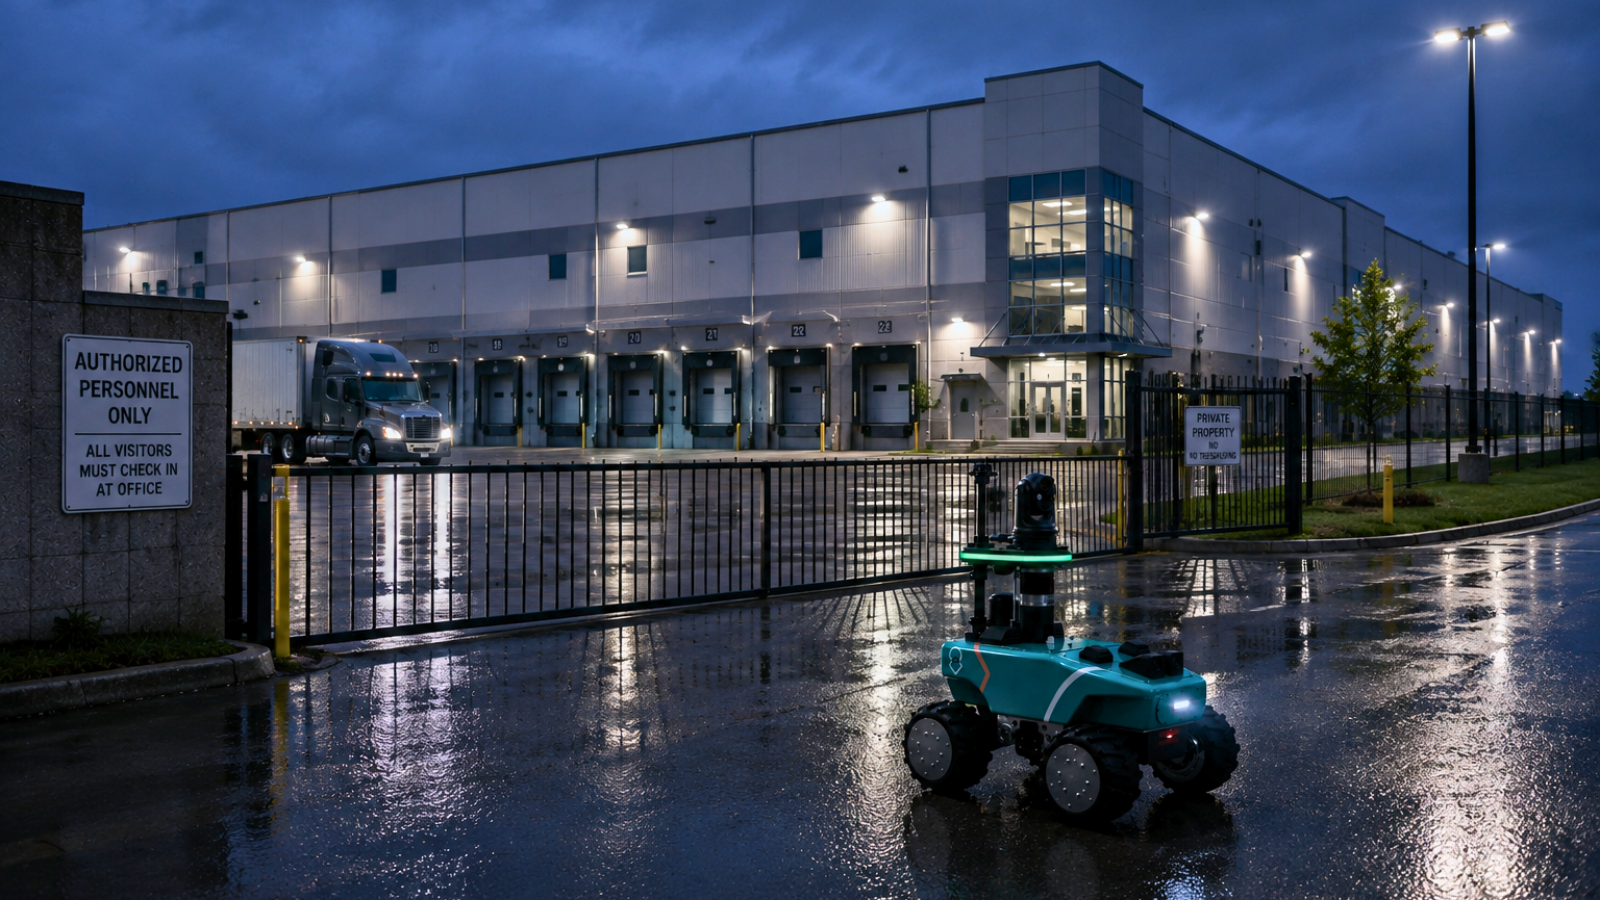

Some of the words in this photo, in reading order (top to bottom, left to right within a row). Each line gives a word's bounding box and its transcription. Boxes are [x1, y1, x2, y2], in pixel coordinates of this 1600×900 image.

[628, 332, 641, 343] 20
[75, 352, 183, 373] AUTHORIZED
[79, 379, 179, 399] PERSONNEL
[108, 406, 152, 424] ONLY
[1197, 413, 1230, 423] PRIVATE
[1192, 427, 1235, 438] PROPERTY
[86, 444, 111, 458] ALL
[114, 443, 172, 457] VISITORS
[80, 463, 117, 478] MUST
[120, 463, 162, 477] CHECK
[166, 463, 178, 476] IN
[96, 482, 114, 497] AT
[117, 481, 163, 496] OFFICE
